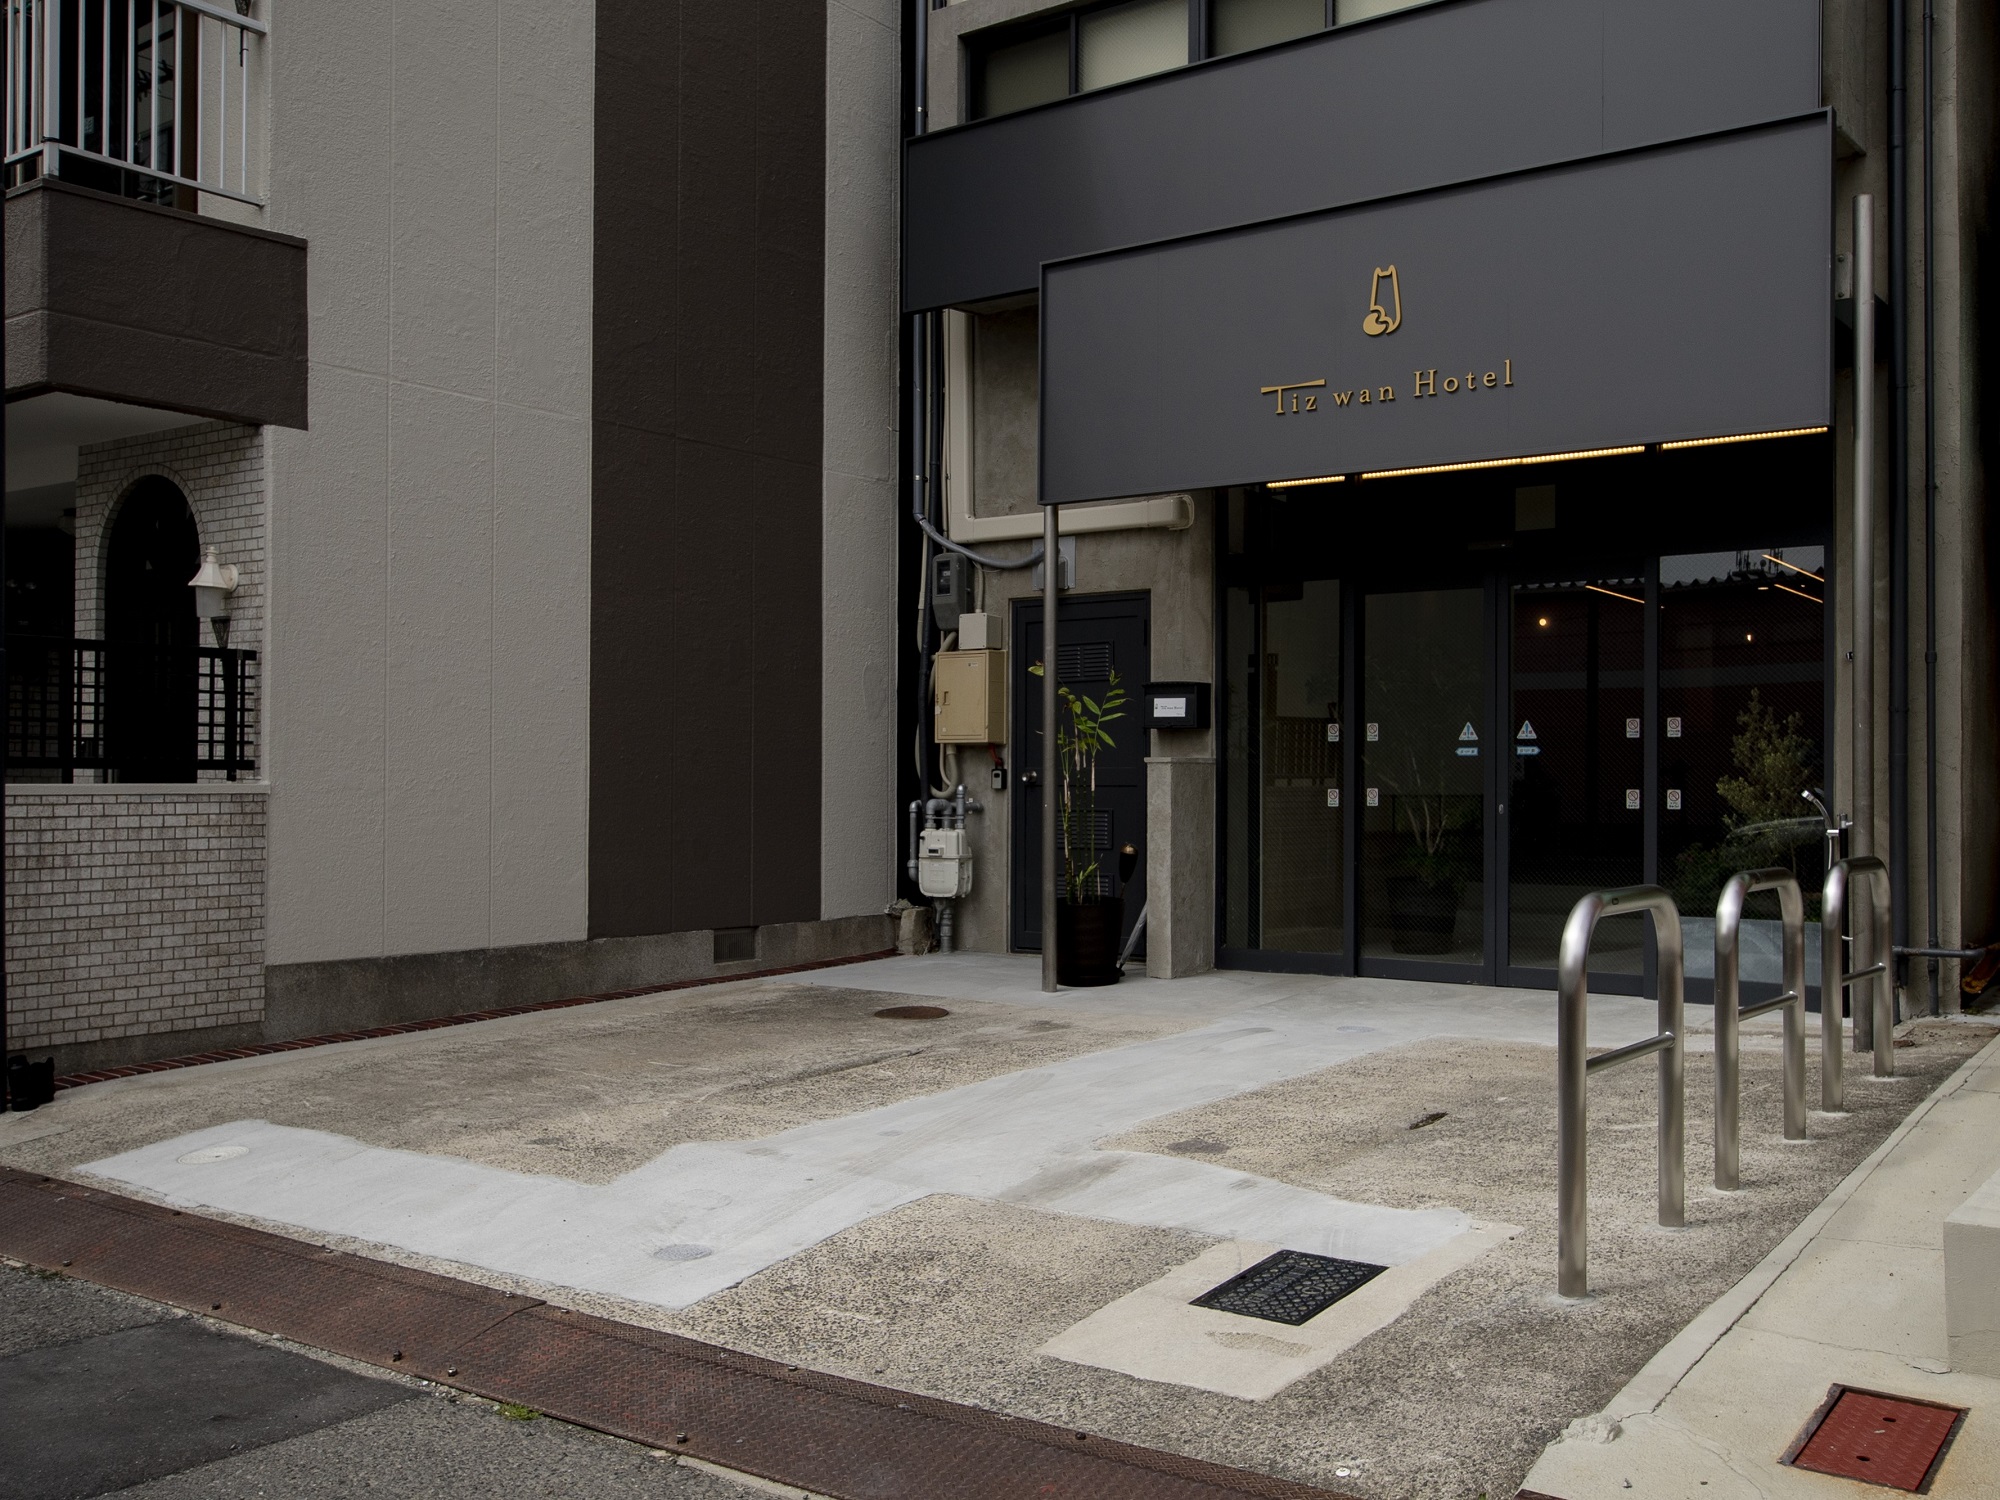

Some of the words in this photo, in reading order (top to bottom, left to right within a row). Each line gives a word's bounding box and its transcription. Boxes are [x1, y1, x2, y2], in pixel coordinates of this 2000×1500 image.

[1260, 378, 1327, 415] Tiz
[1333, 385, 1395, 407] wan
[1414, 359, 1513, 397] Hotel
